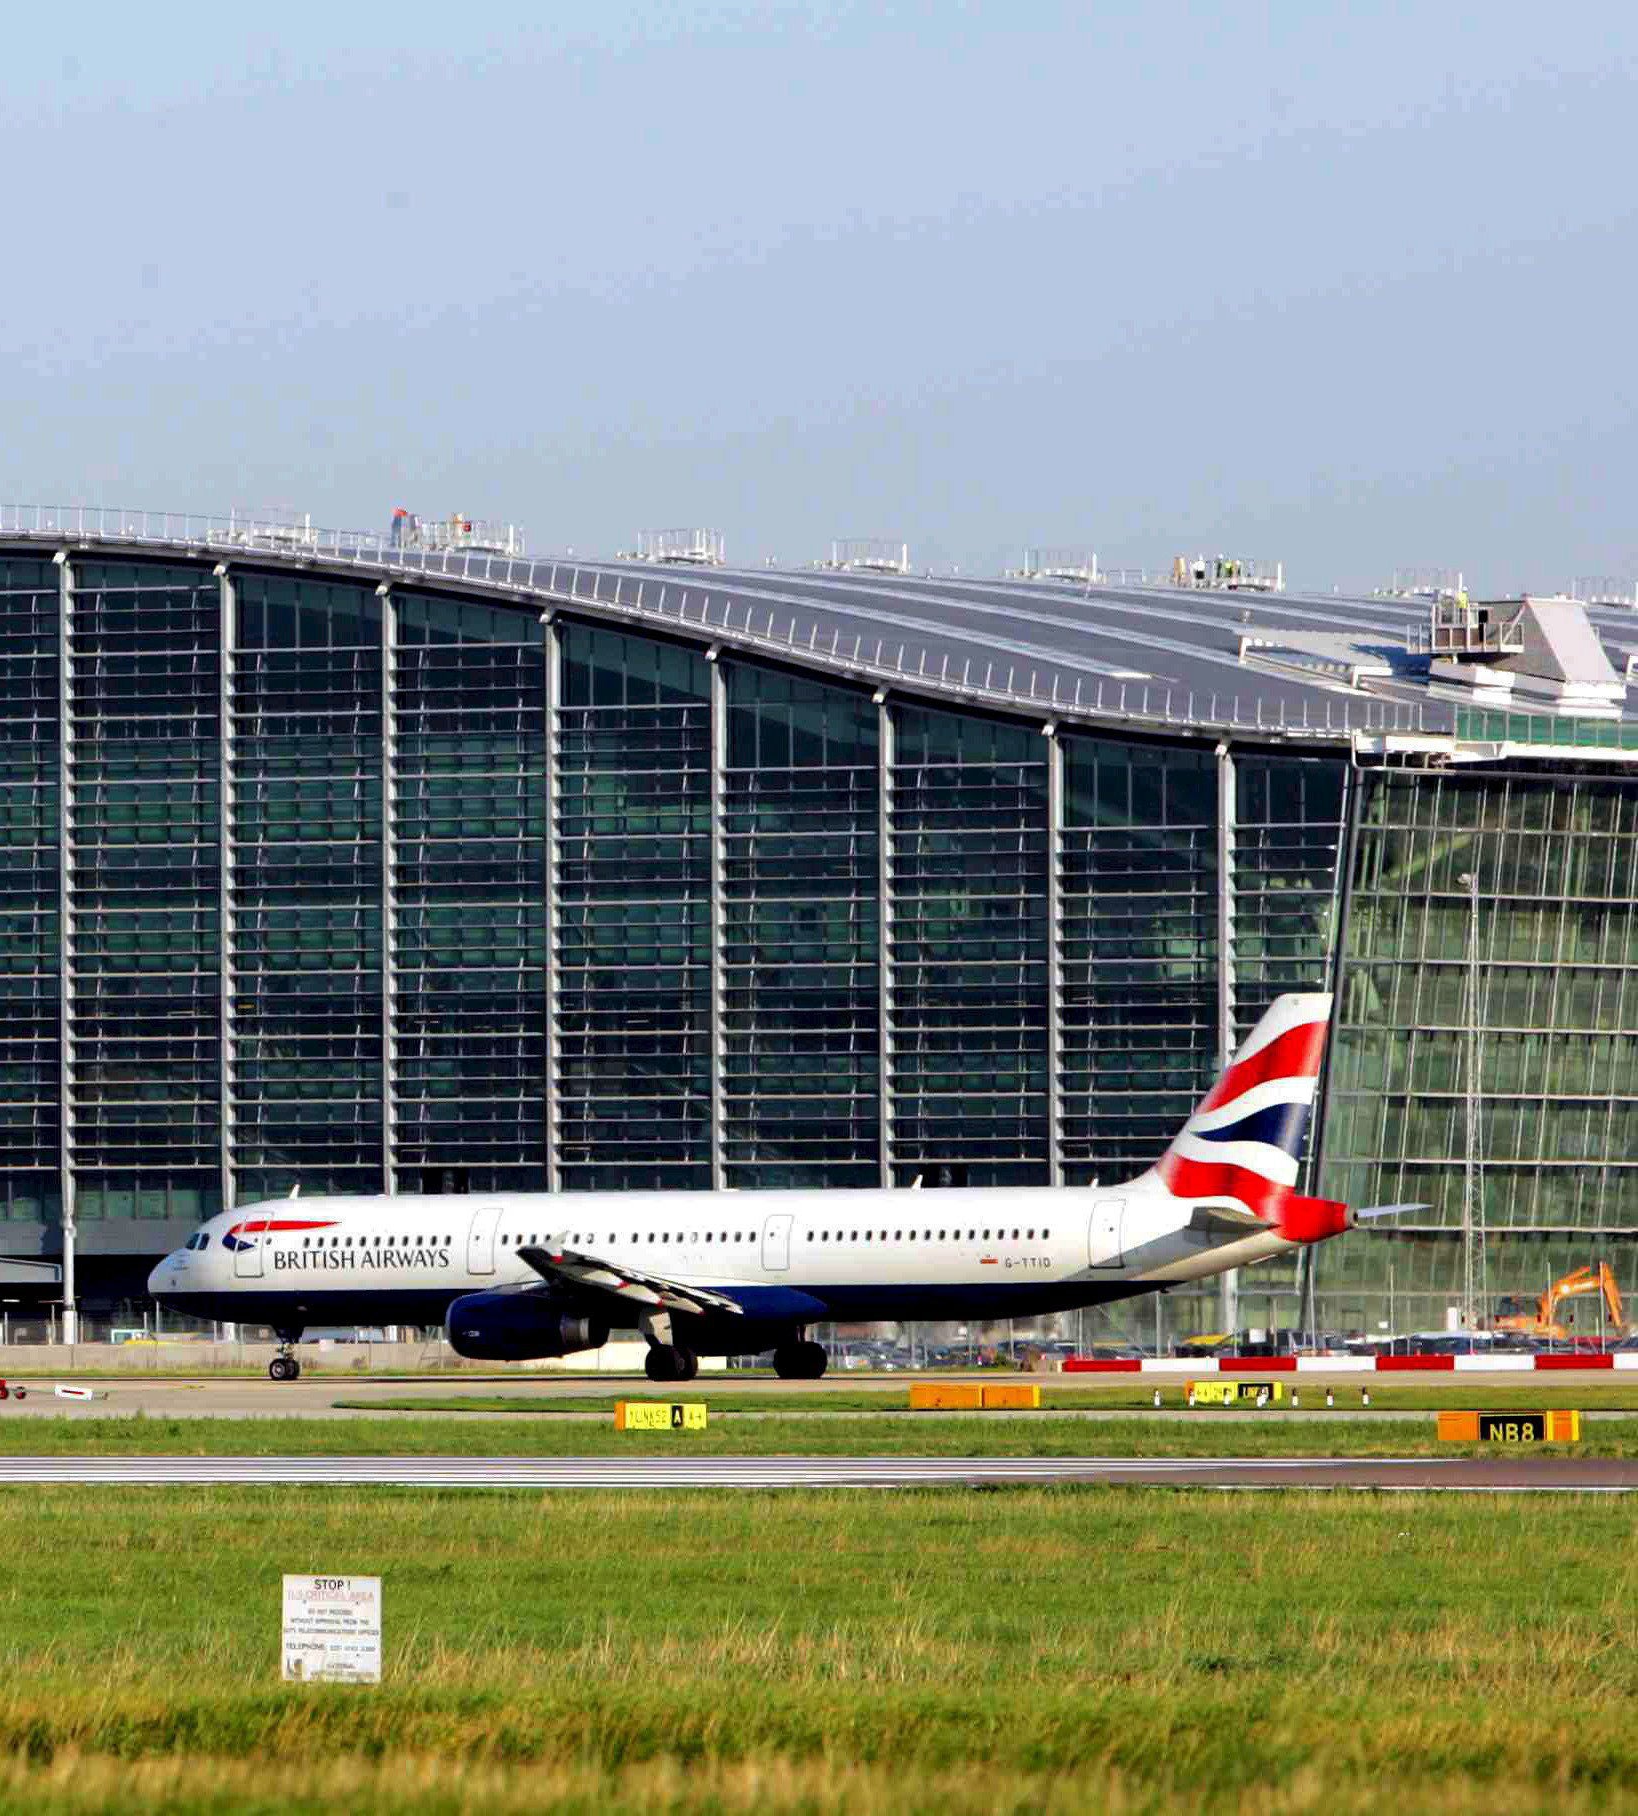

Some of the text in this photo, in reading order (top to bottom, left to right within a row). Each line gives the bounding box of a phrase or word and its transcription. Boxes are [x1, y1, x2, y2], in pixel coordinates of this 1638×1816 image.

[274, 1249, 450, 1270] BRITISH AIRWAYS
[674, 1409, 682, 1424] A
[1489, 1422, 1535, 1441] NB8
[314, 1578, 345, 1591] STOP
